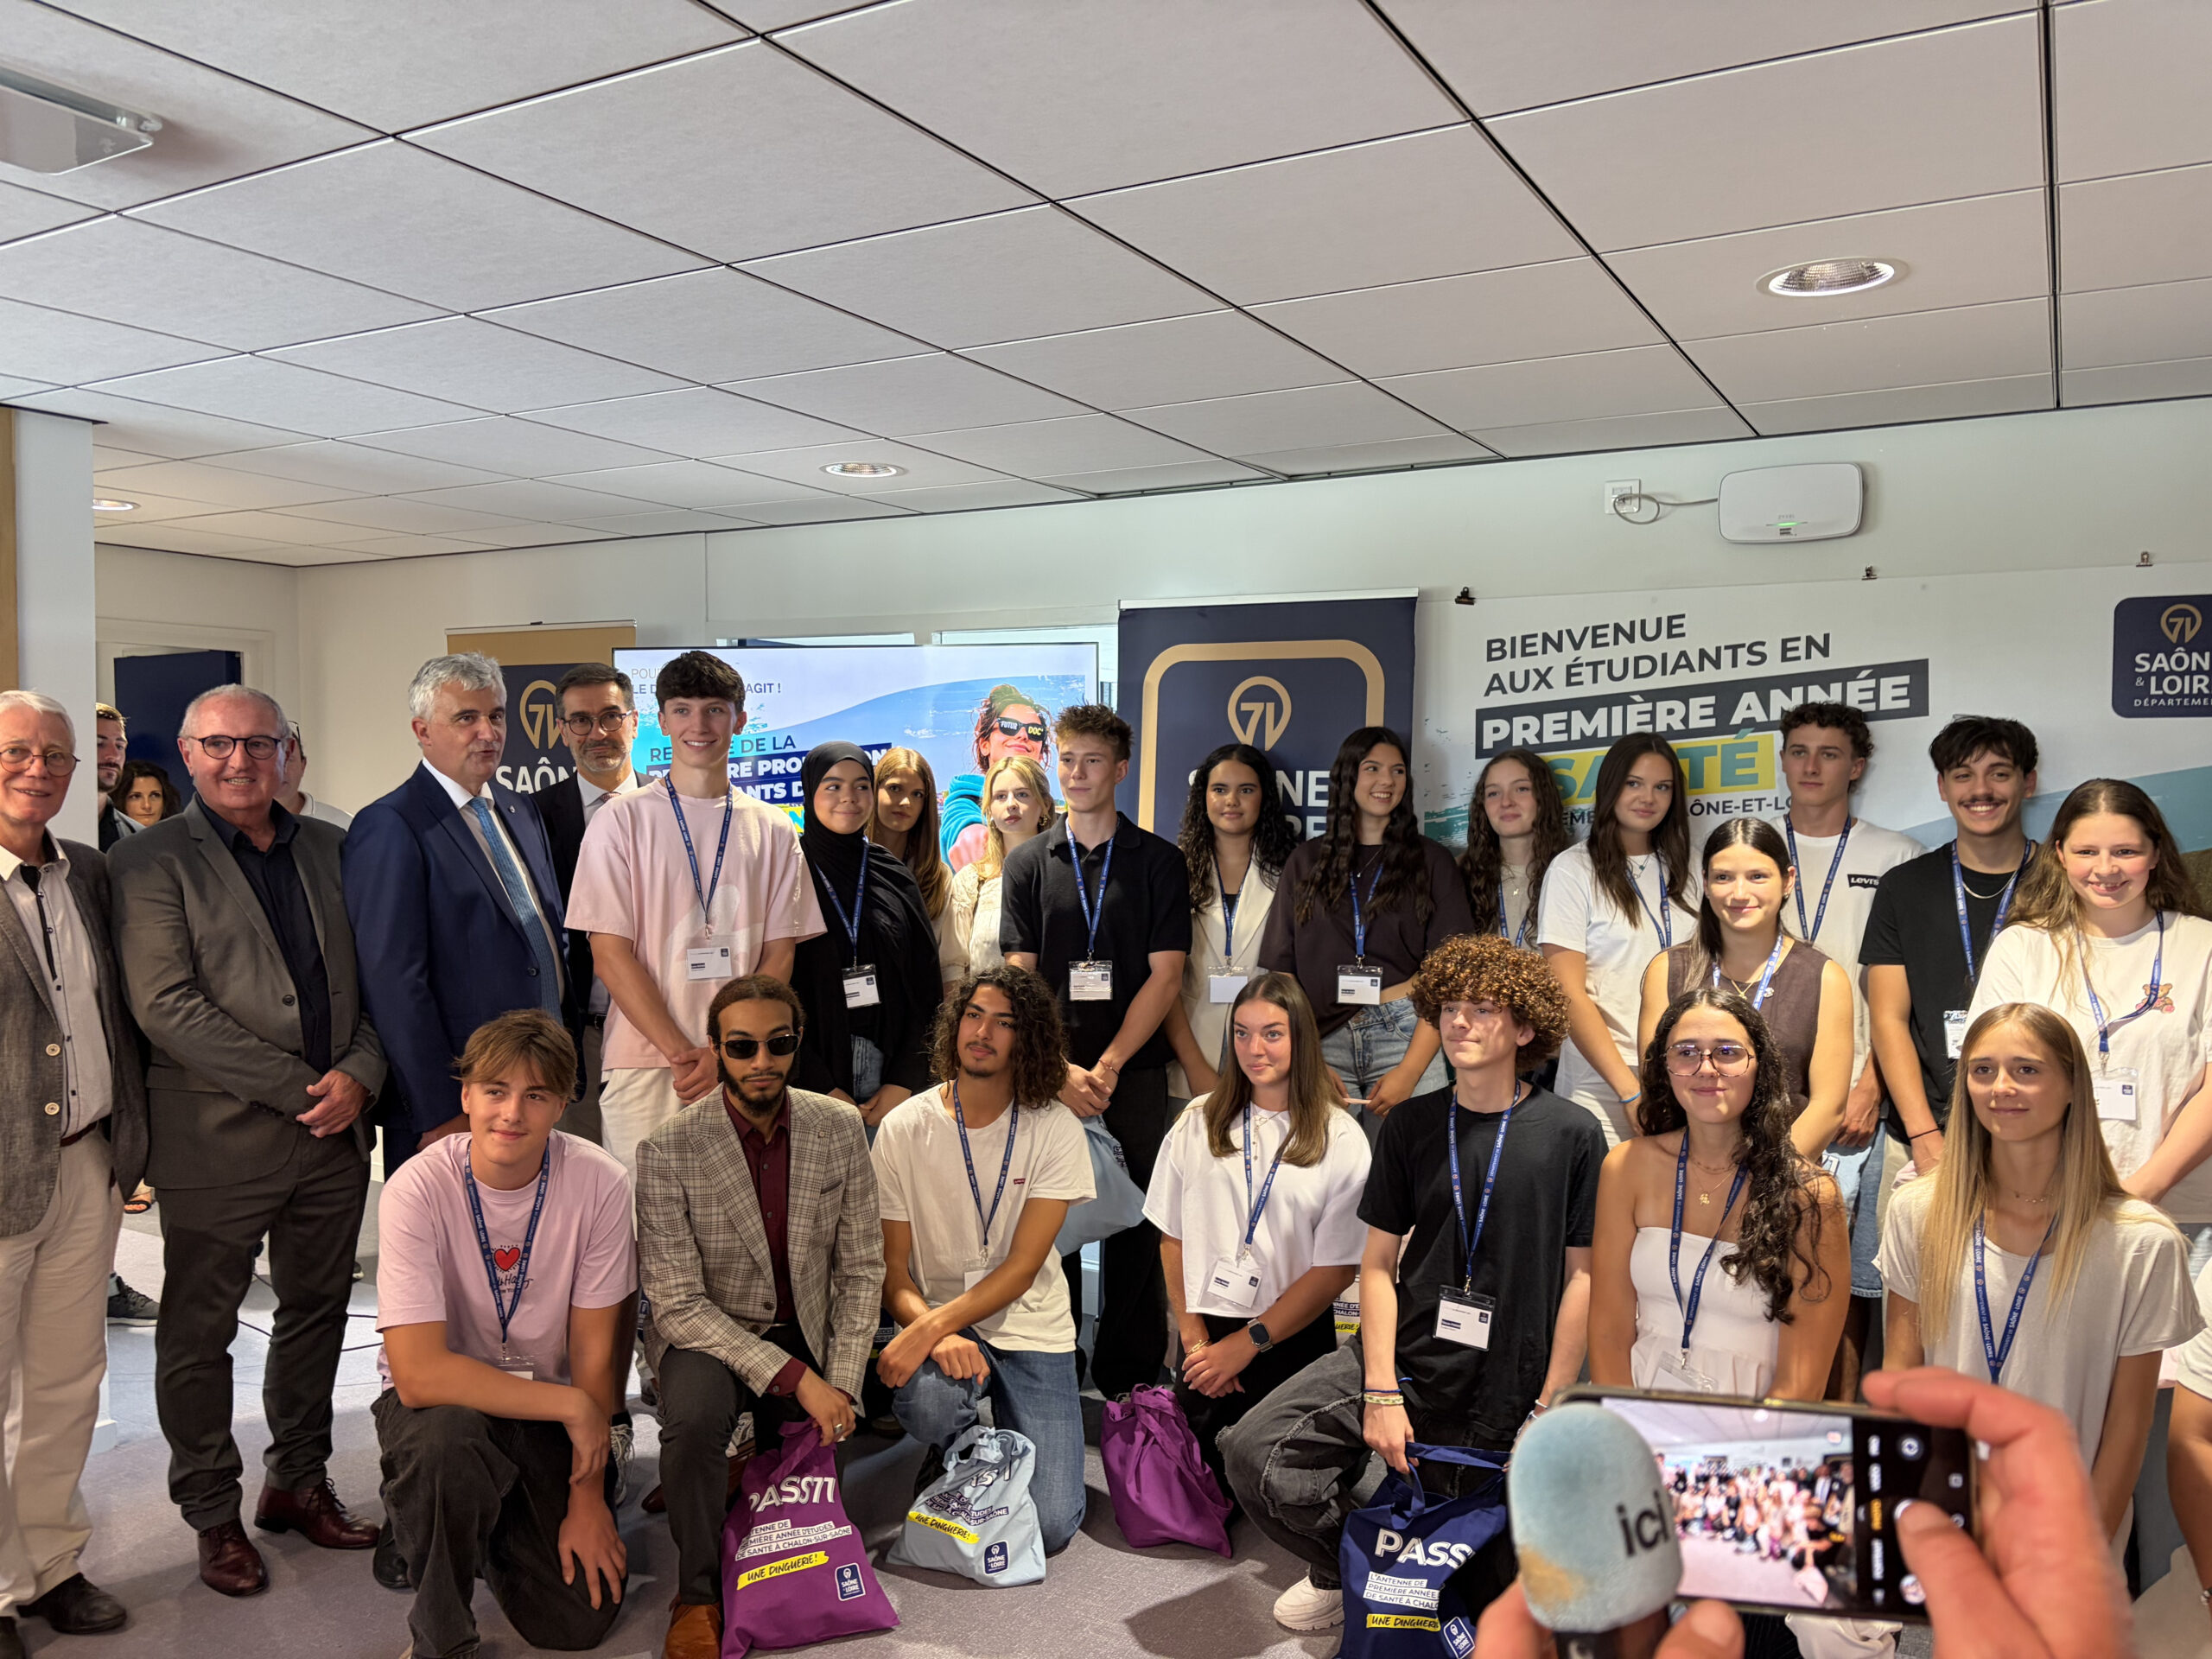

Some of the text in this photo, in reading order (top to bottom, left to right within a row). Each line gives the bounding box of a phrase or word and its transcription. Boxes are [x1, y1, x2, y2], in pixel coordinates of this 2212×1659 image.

[1486, 613, 1687, 662] BIENVENUE
[1484, 632, 1831, 697] AUX ÉTUDIANTS EN
[2134, 647, 2211, 672] SAÔN
[2135, 675, 2212, 695] & LOIR
[2133, 698, 2212, 707] DÉPARTEME
[1482, 695, 1717, 750] PREMIÈRE
[741, 737, 766, 753] DE
[772, 735, 796, 750] LA
[778, 1521, 789, 1529] DE
[1616, 1490, 1669, 1557] ici
[747, 1545, 773, 1555] SANTÉ
[782, 1528, 851, 1549] CHALON-SUR-SAÔNE
[776, 1529, 801, 1539] ANNÉE
[747, 1569, 766, 1581] UNE
[1370, 1573, 1414, 1586] L'ANTENNE
[1379, 1594, 1404, 1604] SANTÉ
[1408, 1588, 1436, 1599] ANNÉE
[1371, 1616, 1392, 1626] UNE
